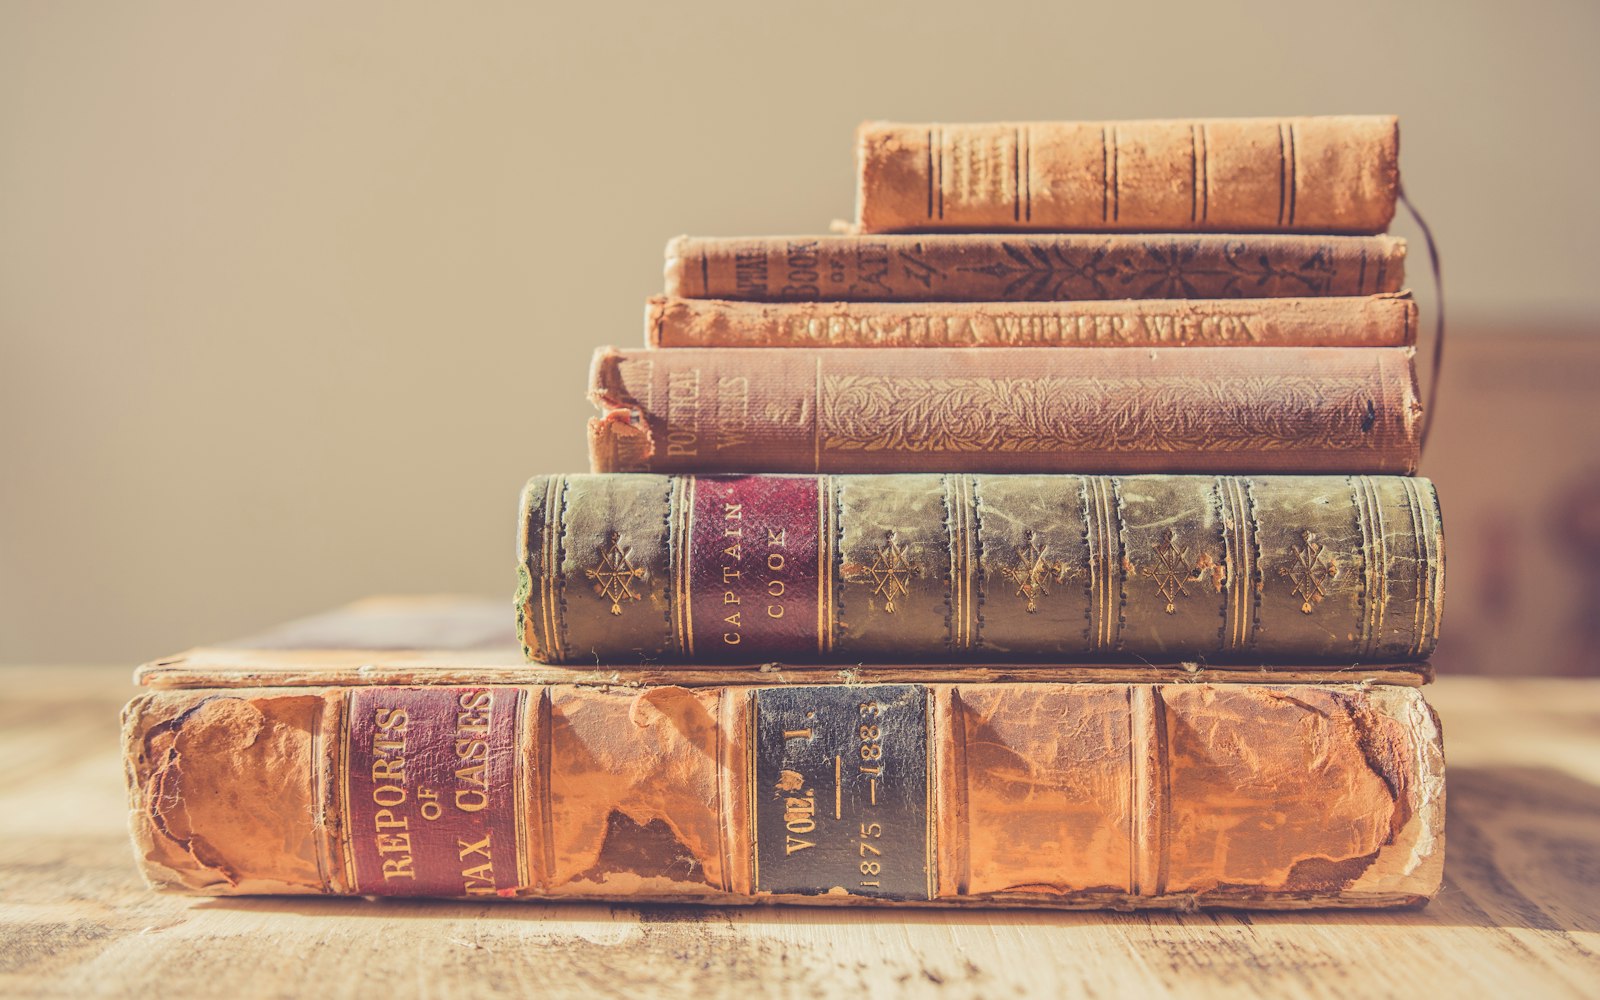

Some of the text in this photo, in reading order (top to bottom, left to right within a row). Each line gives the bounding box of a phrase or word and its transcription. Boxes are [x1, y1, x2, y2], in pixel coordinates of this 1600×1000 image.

[782, 240, 819, 299] BOOK
[829, 258, 846, 283] OF
[667, 368, 700, 457] POETICAL
[716, 376, 749, 450] WORKS
[723, 502, 743, 645] CAPTAIN
[767, 527, 786, 619] COOK
[372, 707, 417, 881] REPORTS
[417, 785, 442, 821] OF
[455, 690, 497, 896] TAX CASES
